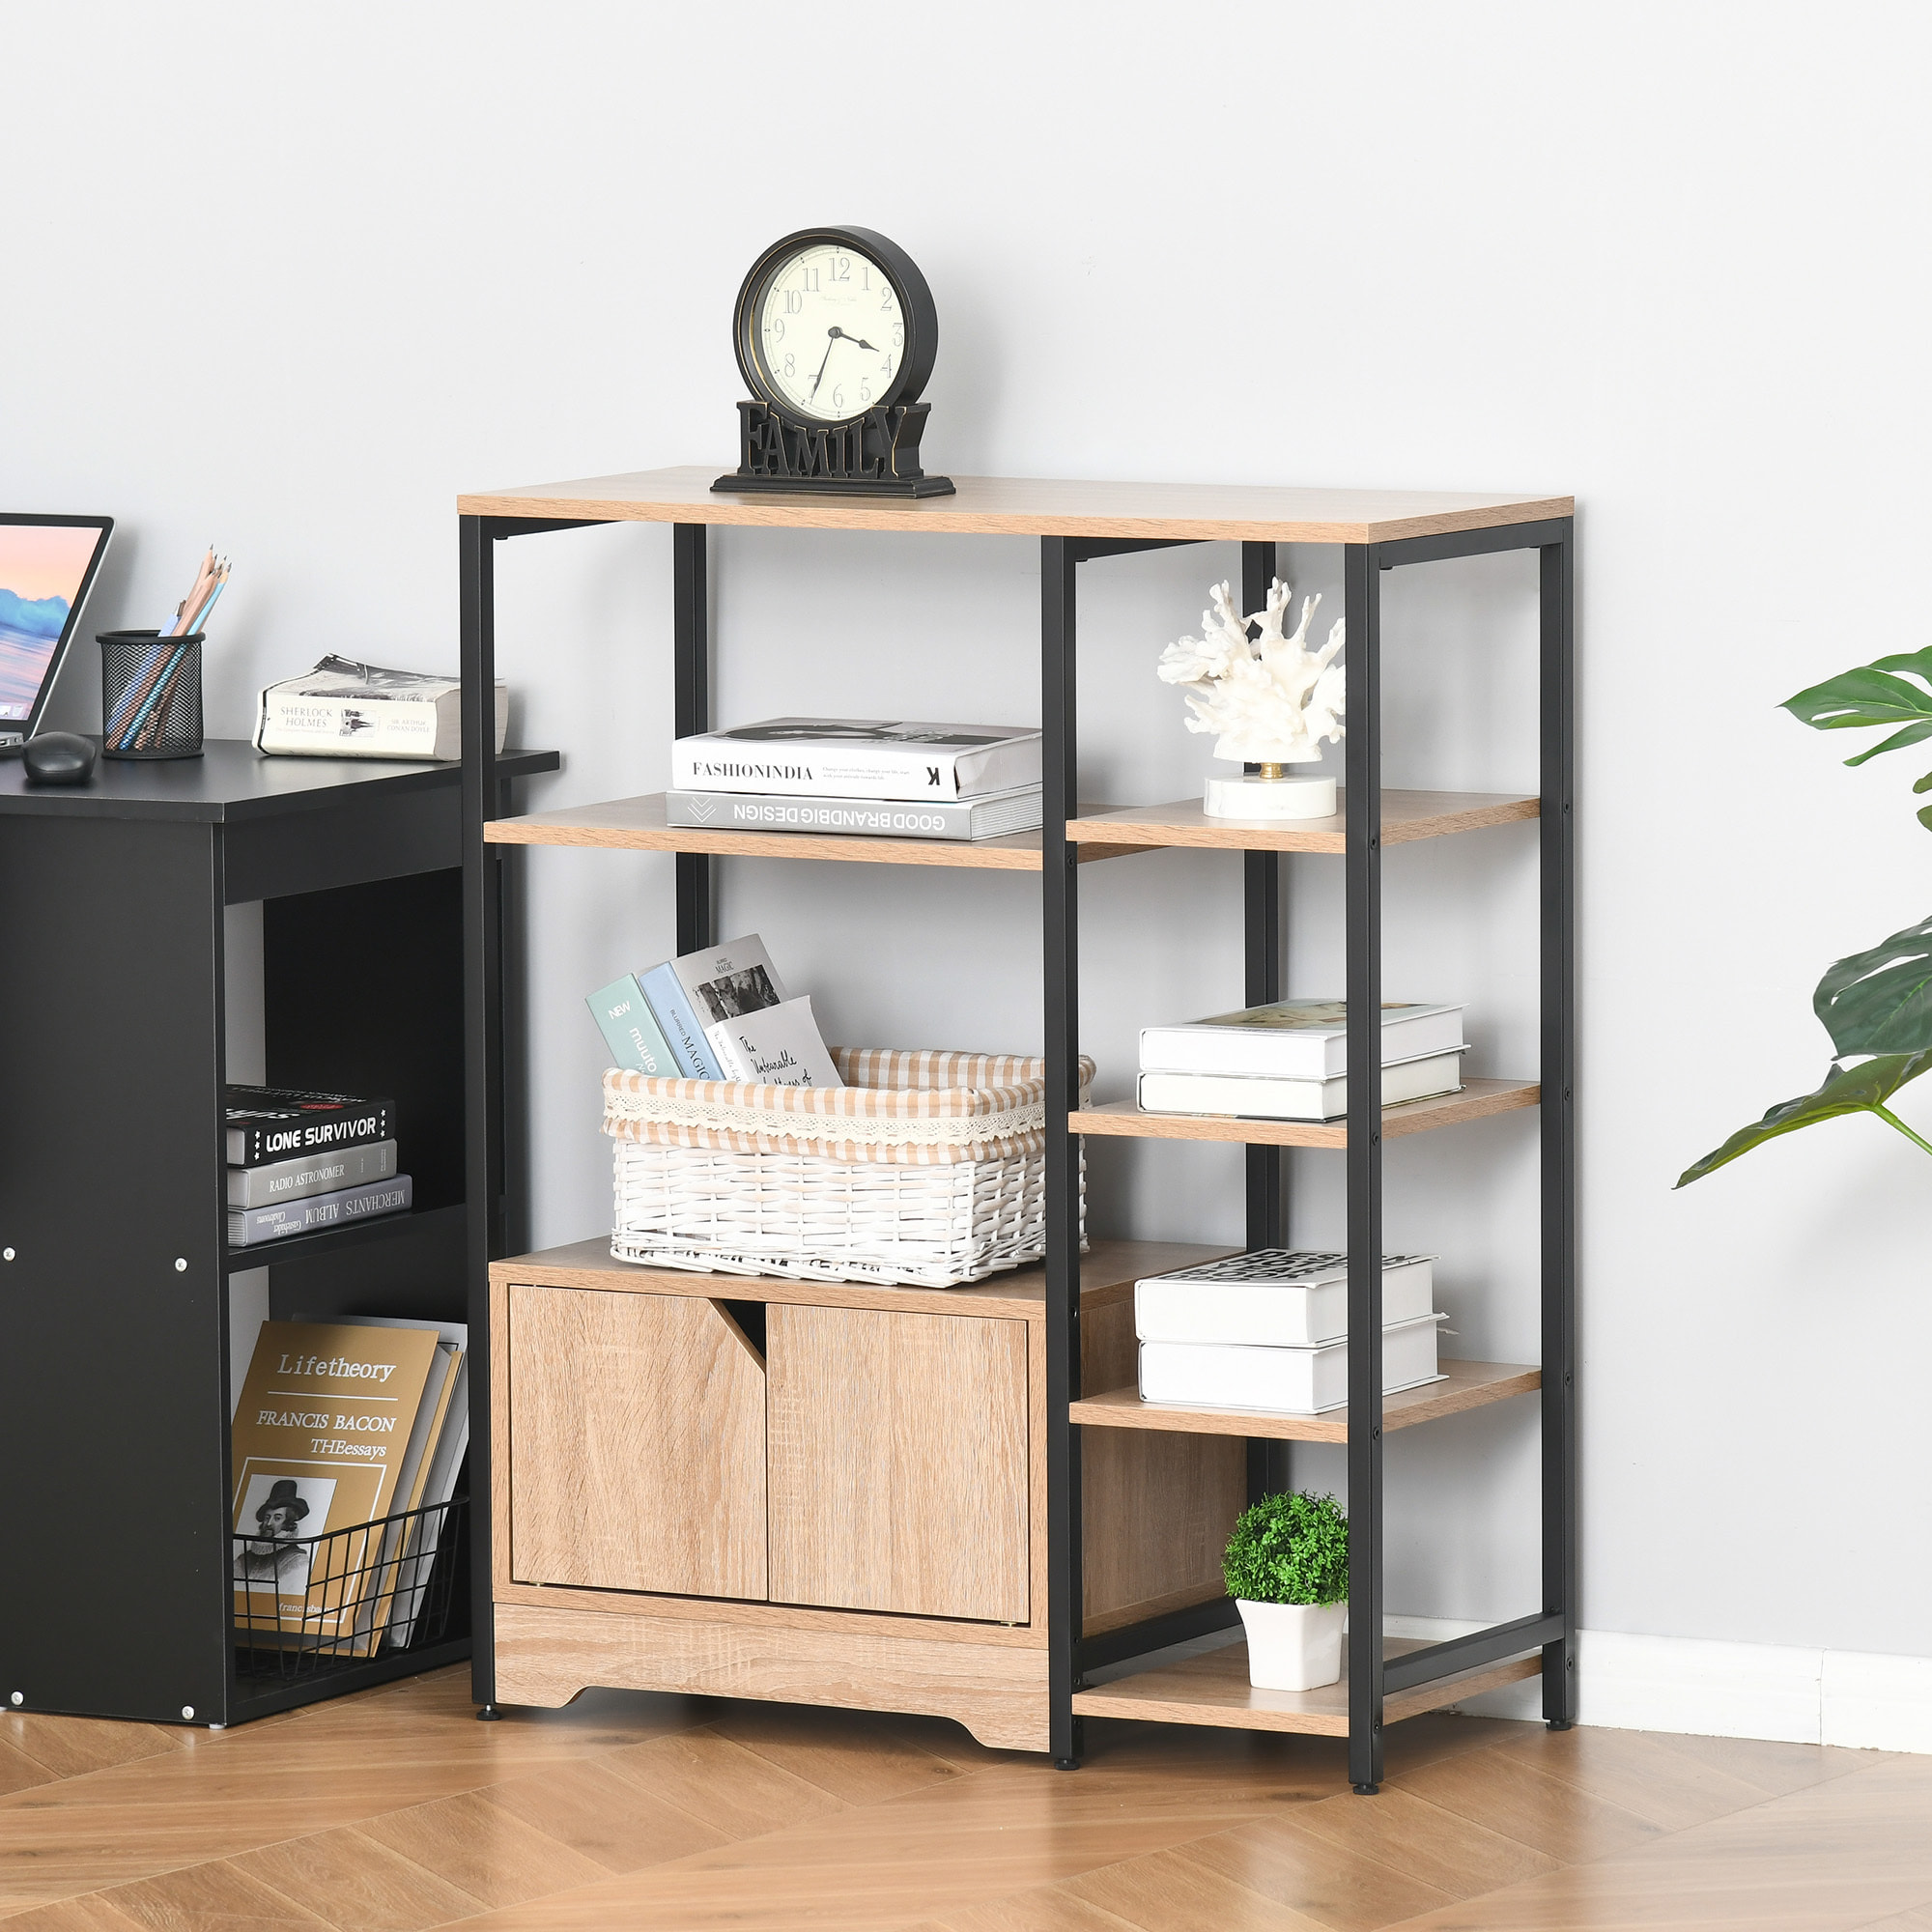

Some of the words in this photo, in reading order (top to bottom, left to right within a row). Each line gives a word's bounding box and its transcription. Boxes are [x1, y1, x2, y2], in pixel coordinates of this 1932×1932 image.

[802, 268, 821, 292] 11
[828, 257, 850, 281] 12
[862, 267, 871, 291] 1
[783, 289, 802, 314] 10
[880, 287, 893, 311] 2
[775, 319, 785, 343] 9
[893, 323, 903, 347] 3
[784, 353, 796, 377] 8
[880, 354, 892, 378] 4
[833, 384, 843, 408] 6
[860, 377, 871, 401] 5
[737, 402, 910, 478] FAMILY
[280, 706, 332, 718] SHERLOCK
[286, 717, 327, 727] HOLMES
[693, 762, 813, 781] FASHIONINDIA
[733, 804, 798, 823] DESIGN
[608, 1000, 632, 1020] NEW
[629, 1027, 658, 1071] muuto
[669, 1009, 687, 1037] BLURRED
[682, 1036, 712, 1081] MAGIC
[739, 1036, 756, 1053] The
[750, 1049, 797, 1074] Unbearable
[266, 1129, 301, 1152] LONE
[304, 1117, 377, 1146] SURVIVOR
[270, 1176, 293, 1193] RADIO
[295, 1165, 345, 1186] ASTRONOMER
[305, 1203, 340, 1224] ALBUM
[346, 1189, 405, 1216] MERCHANTS
[1181, 1268, 1310, 1278] BOOK
[1211, 1263, 1326, 1274] YEAR
[276, 1353, 397, 1382] Lifetheory
[256, 1410, 328, 1429] FRANCIS
[333, 1415, 397, 1433] BACON
[311, 1438, 386, 1461] THEessays
